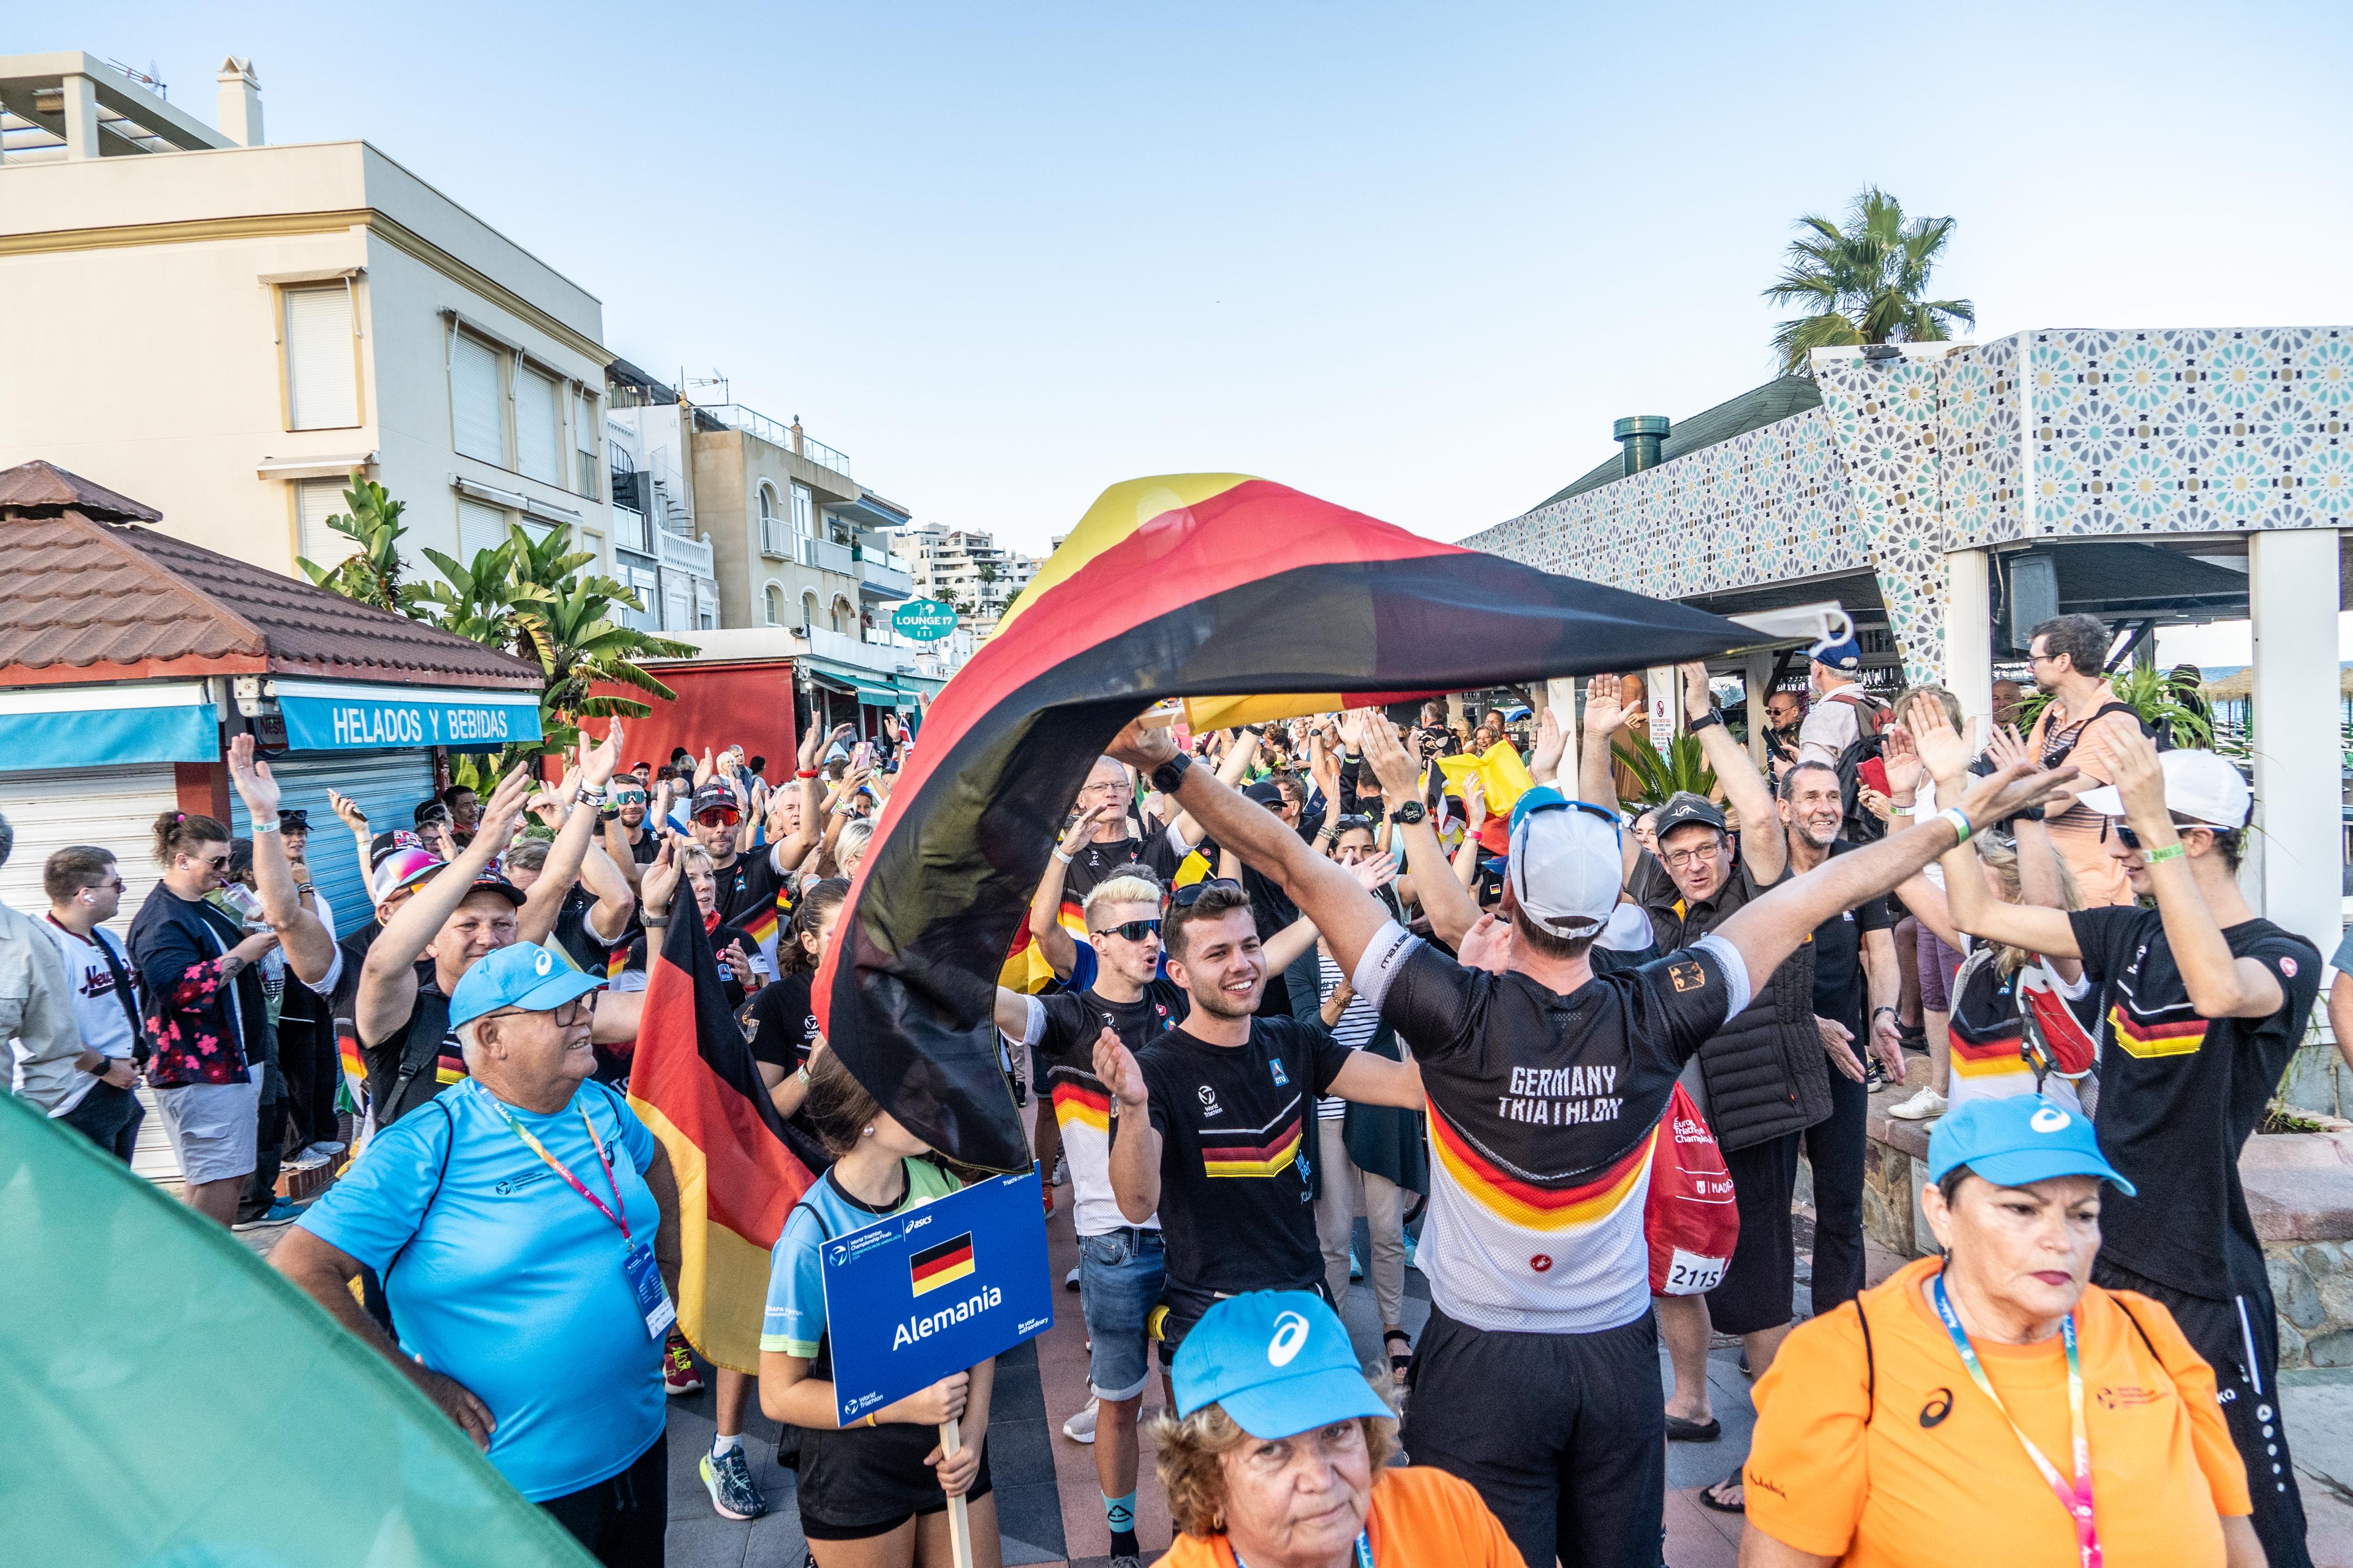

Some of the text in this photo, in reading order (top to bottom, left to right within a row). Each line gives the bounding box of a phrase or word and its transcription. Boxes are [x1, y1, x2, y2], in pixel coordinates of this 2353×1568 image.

[897, 616, 953, 625] LOUNGE 17
[333, 707, 508, 744] HELADOS Y BEBIDAS
[1275, 1075, 1286, 1085] DTU
[1509, 1065, 1617, 1096] GERMANY
[1204, 1103, 1218, 1112] World
[1204, 1108, 1223, 1118] Triathlon
[1498, 1096, 1624, 1125] TRIATHLON
[851, 1232, 892, 1251] Championship Finals
[864, 1230, 882, 1241] Triathlon
[1671, 1265, 1720, 1288] 2115
[893, 1285, 1002, 1351] Alemania
[1024, 1318, 1035, 1328] your
[1019, 1317, 1048, 1335] extraordinary
[859, 1391, 876, 1402] World
[859, 1394, 884, 1409] Triathlon
